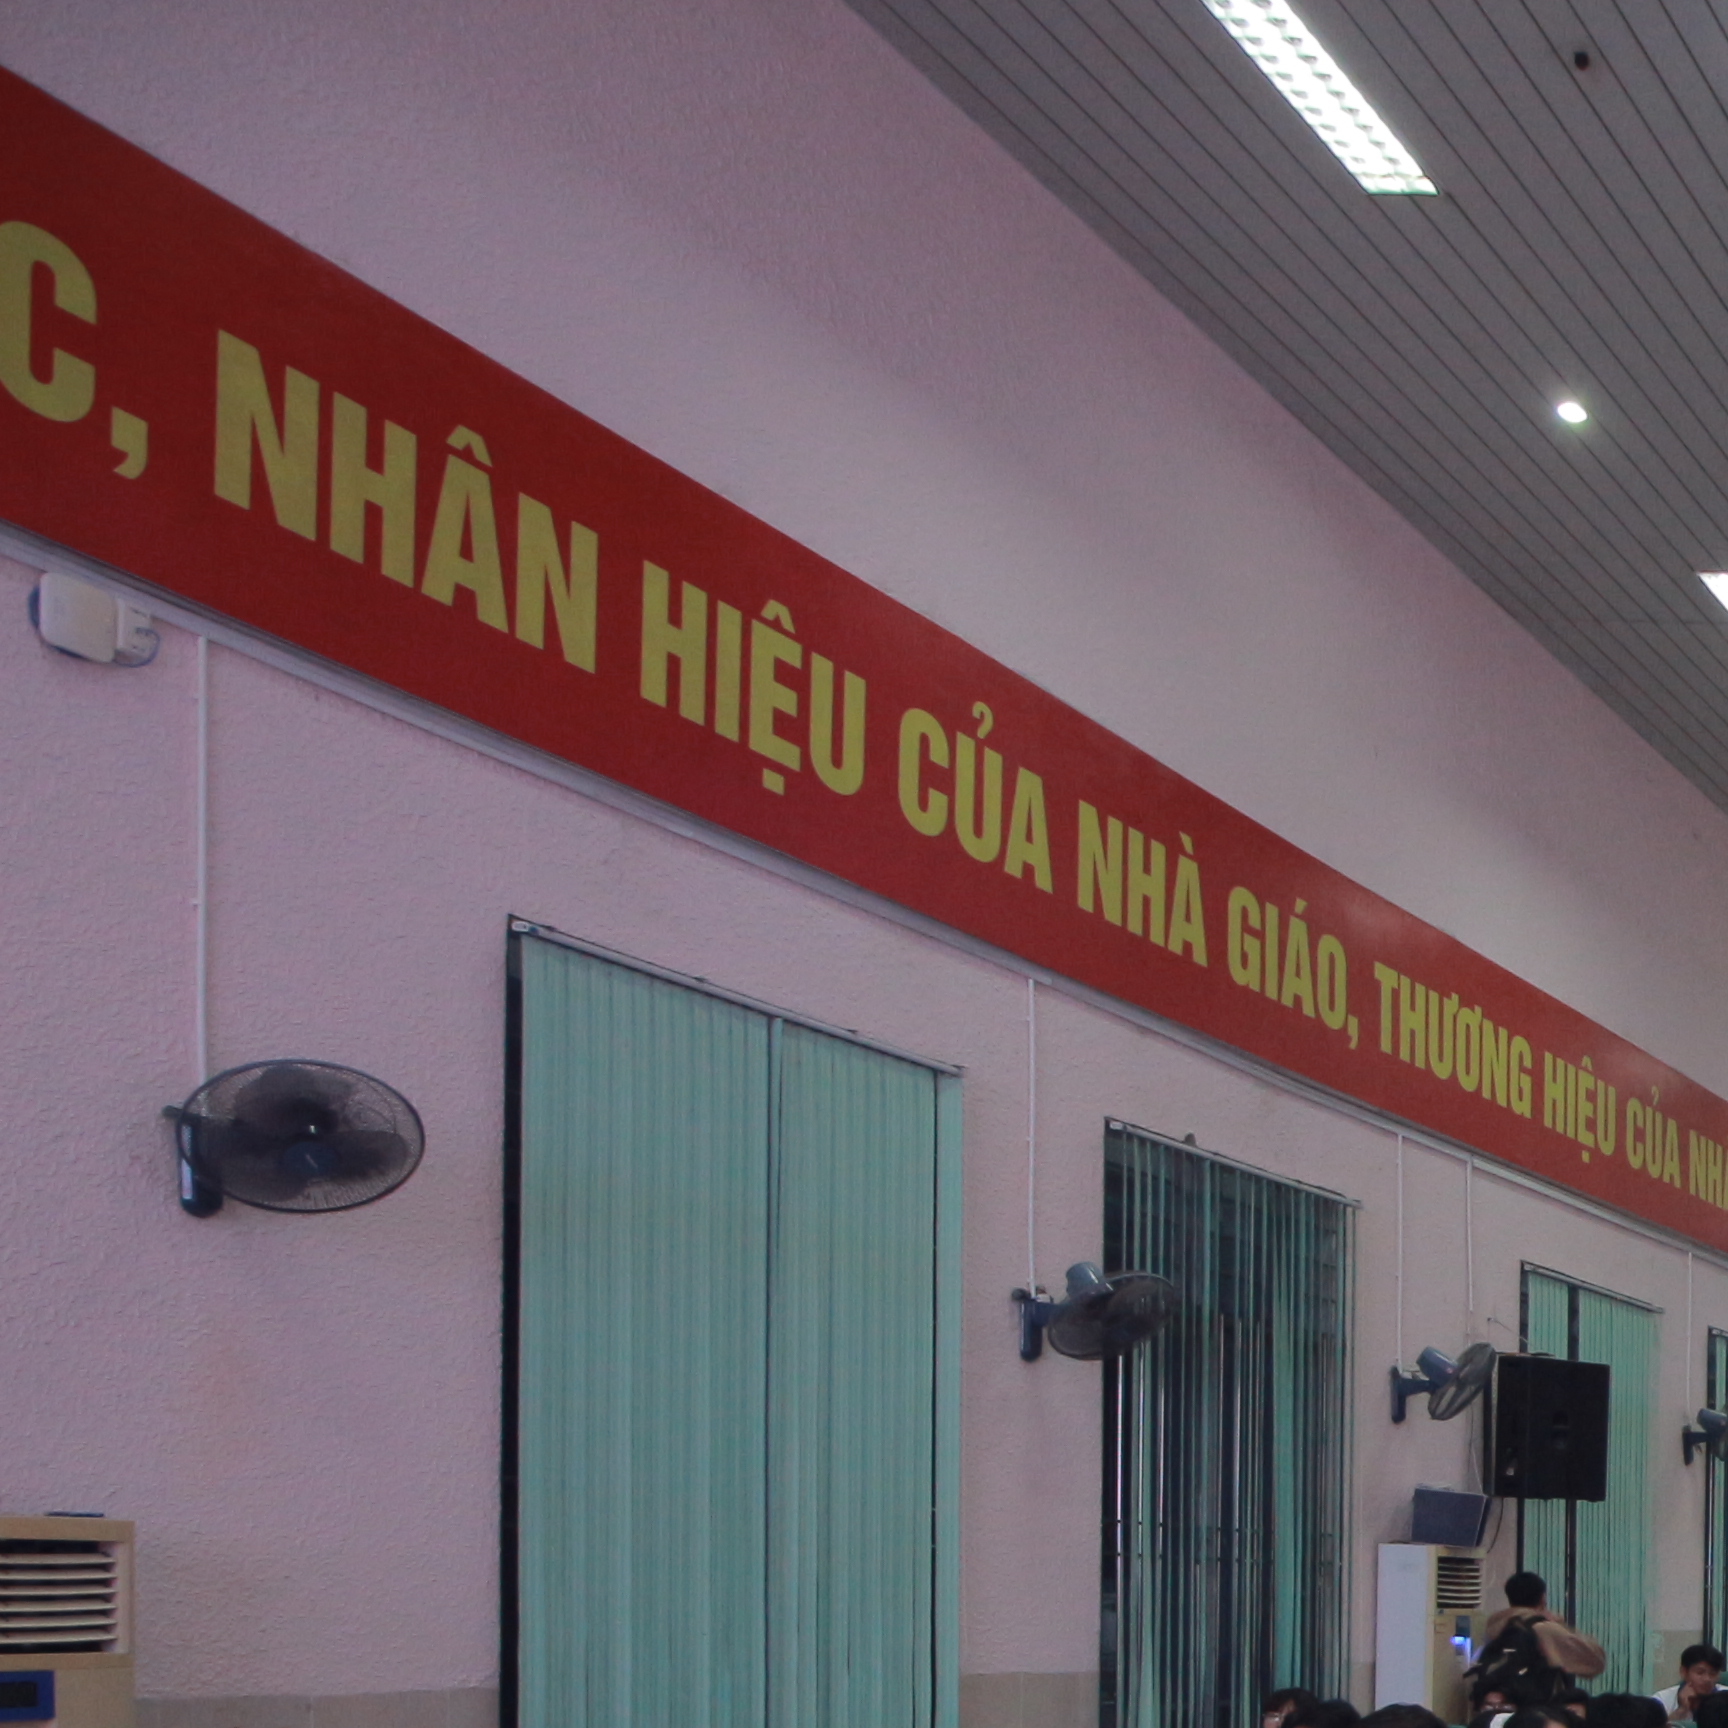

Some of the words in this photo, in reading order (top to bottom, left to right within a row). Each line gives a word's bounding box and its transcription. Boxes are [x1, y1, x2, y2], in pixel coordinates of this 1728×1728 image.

[214, 329, 599, 673] NHÂN
[640, 562, 867, 796] HIỆU
[898, 701, 1054, 893] CỦA
[1077, 800, 1209, 967] NHÀ
[1227, 886, 1359, 1049] GIÁO,
[1373, 963, 1534, 1119] THƯƠNG
[1543, 1052, 1617, 1163] HIỆU
[1625, 1085, 1682, 1188] CỦA
